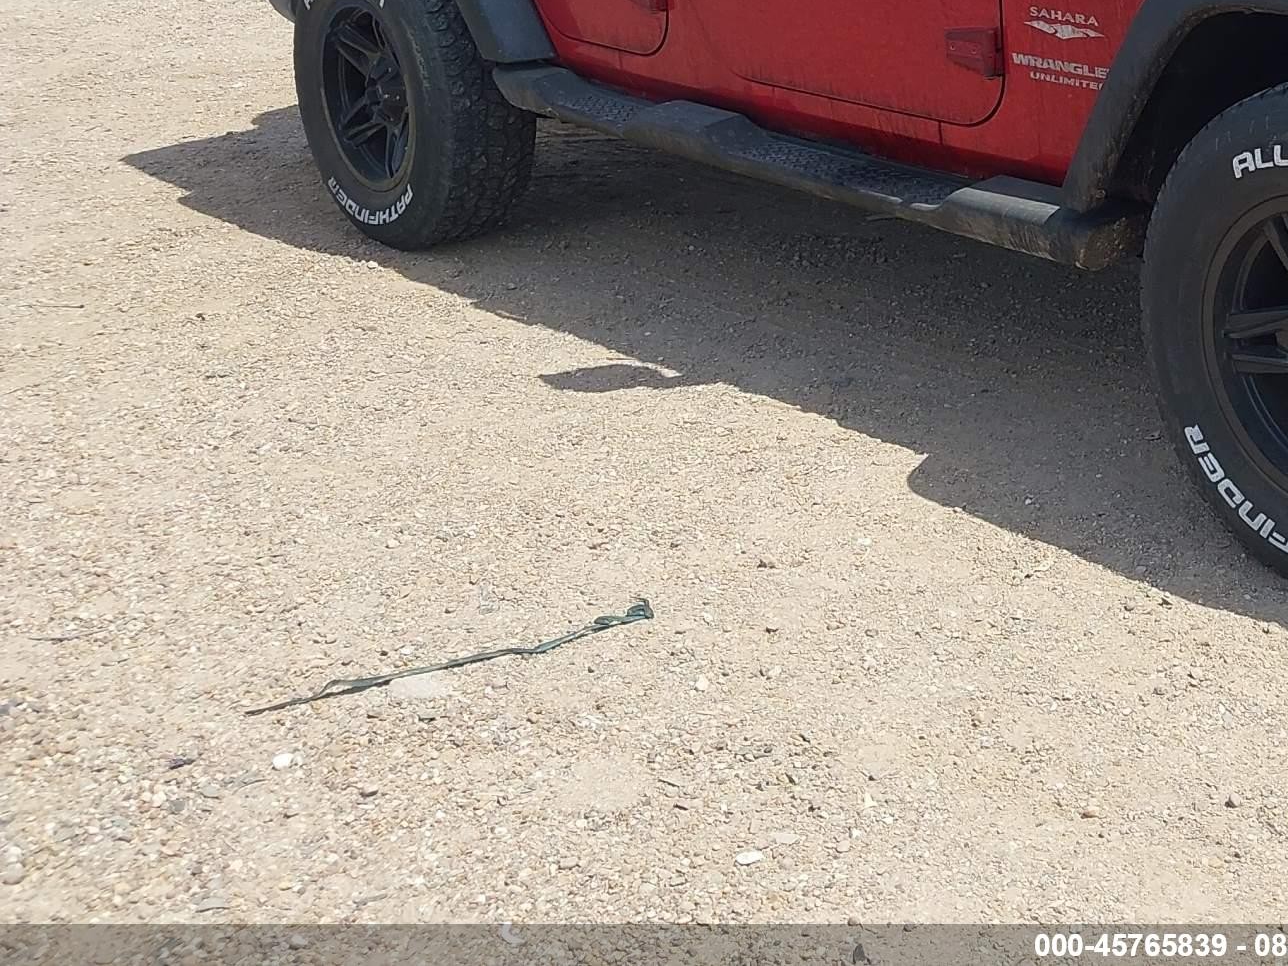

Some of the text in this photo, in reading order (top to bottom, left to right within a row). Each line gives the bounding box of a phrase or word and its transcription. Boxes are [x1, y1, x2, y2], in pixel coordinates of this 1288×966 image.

[1029, 6, 1099, 27] SAHARA
[1011, 52, 1110, 79] WRANGLE
[328, 176, 413, 225] PATHFINDER
